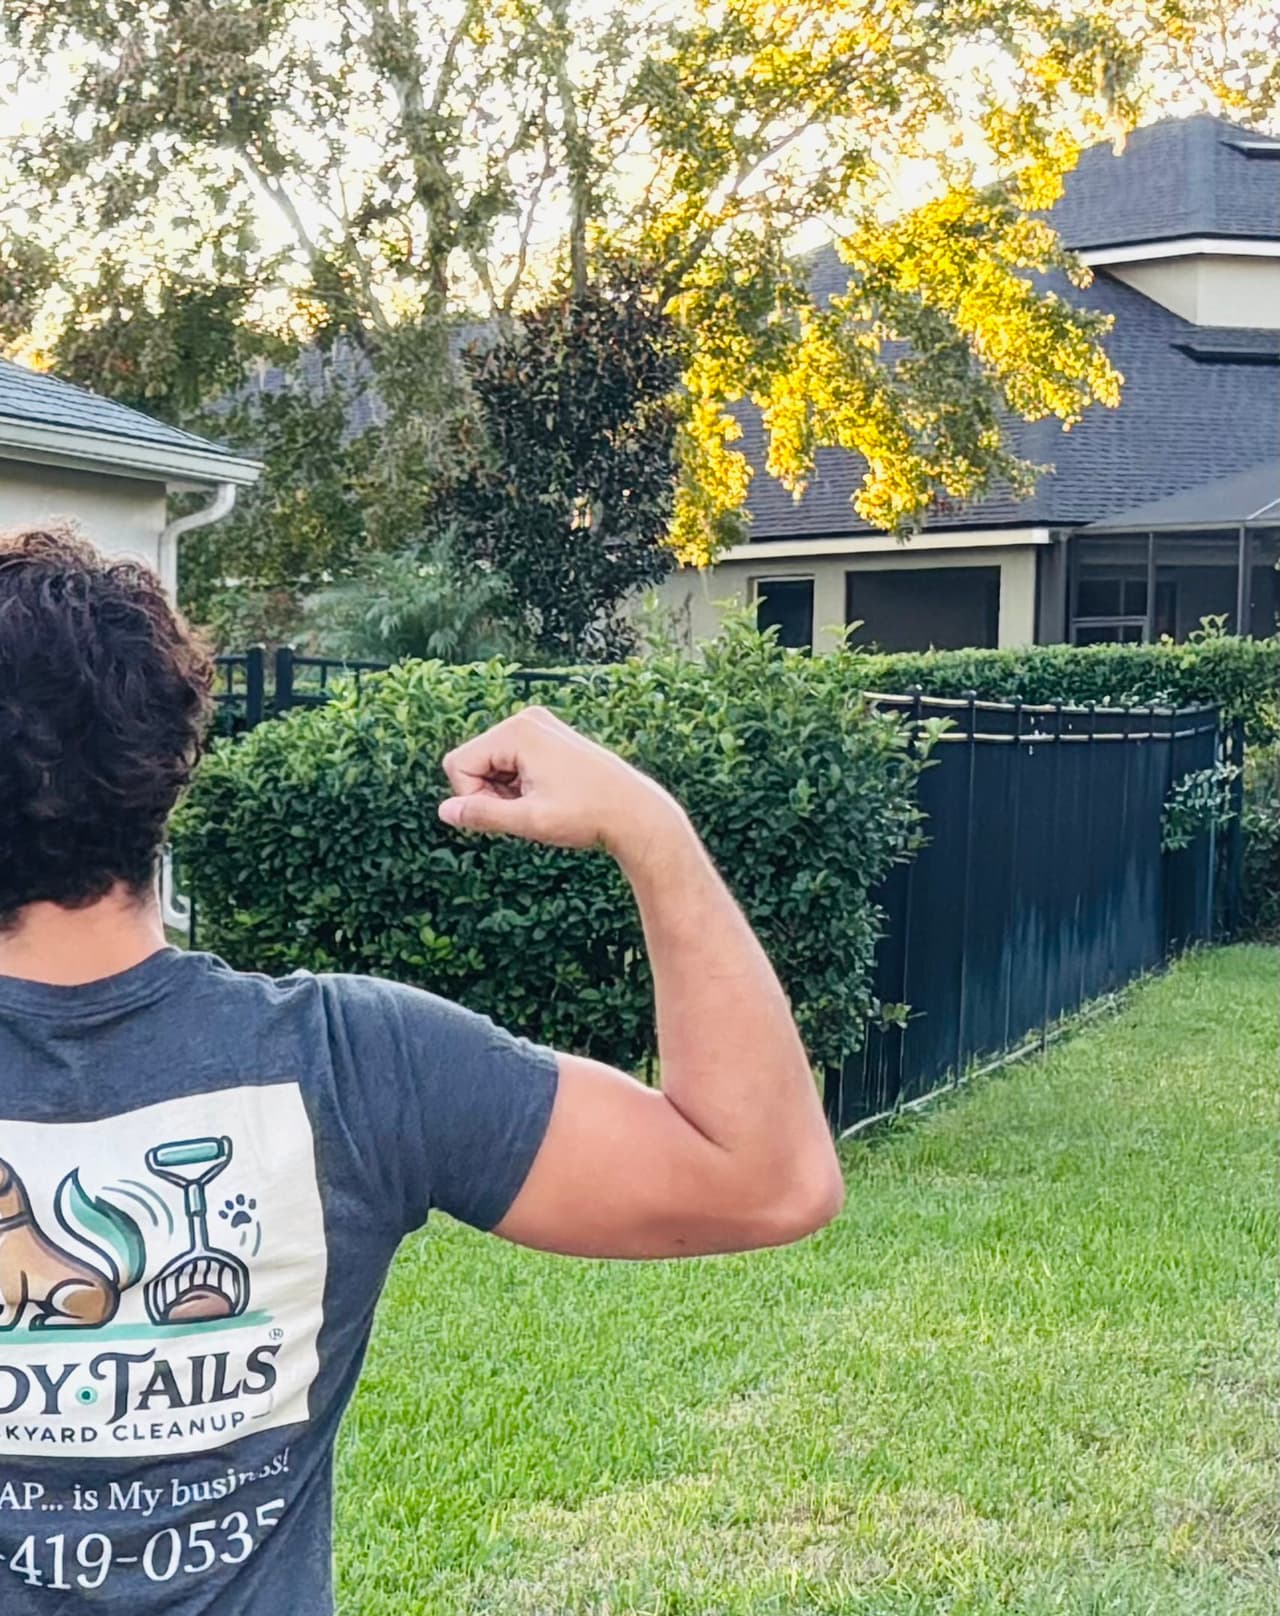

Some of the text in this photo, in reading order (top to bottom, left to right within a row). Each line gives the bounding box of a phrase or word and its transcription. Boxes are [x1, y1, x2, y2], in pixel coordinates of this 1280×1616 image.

[90, 1344, 282, 1425] TAILS
[112, 1412, 245, 1440] CLEANUP
[74, 1485, 98, 1511] is
[108, 1484, 162, 1516] My
